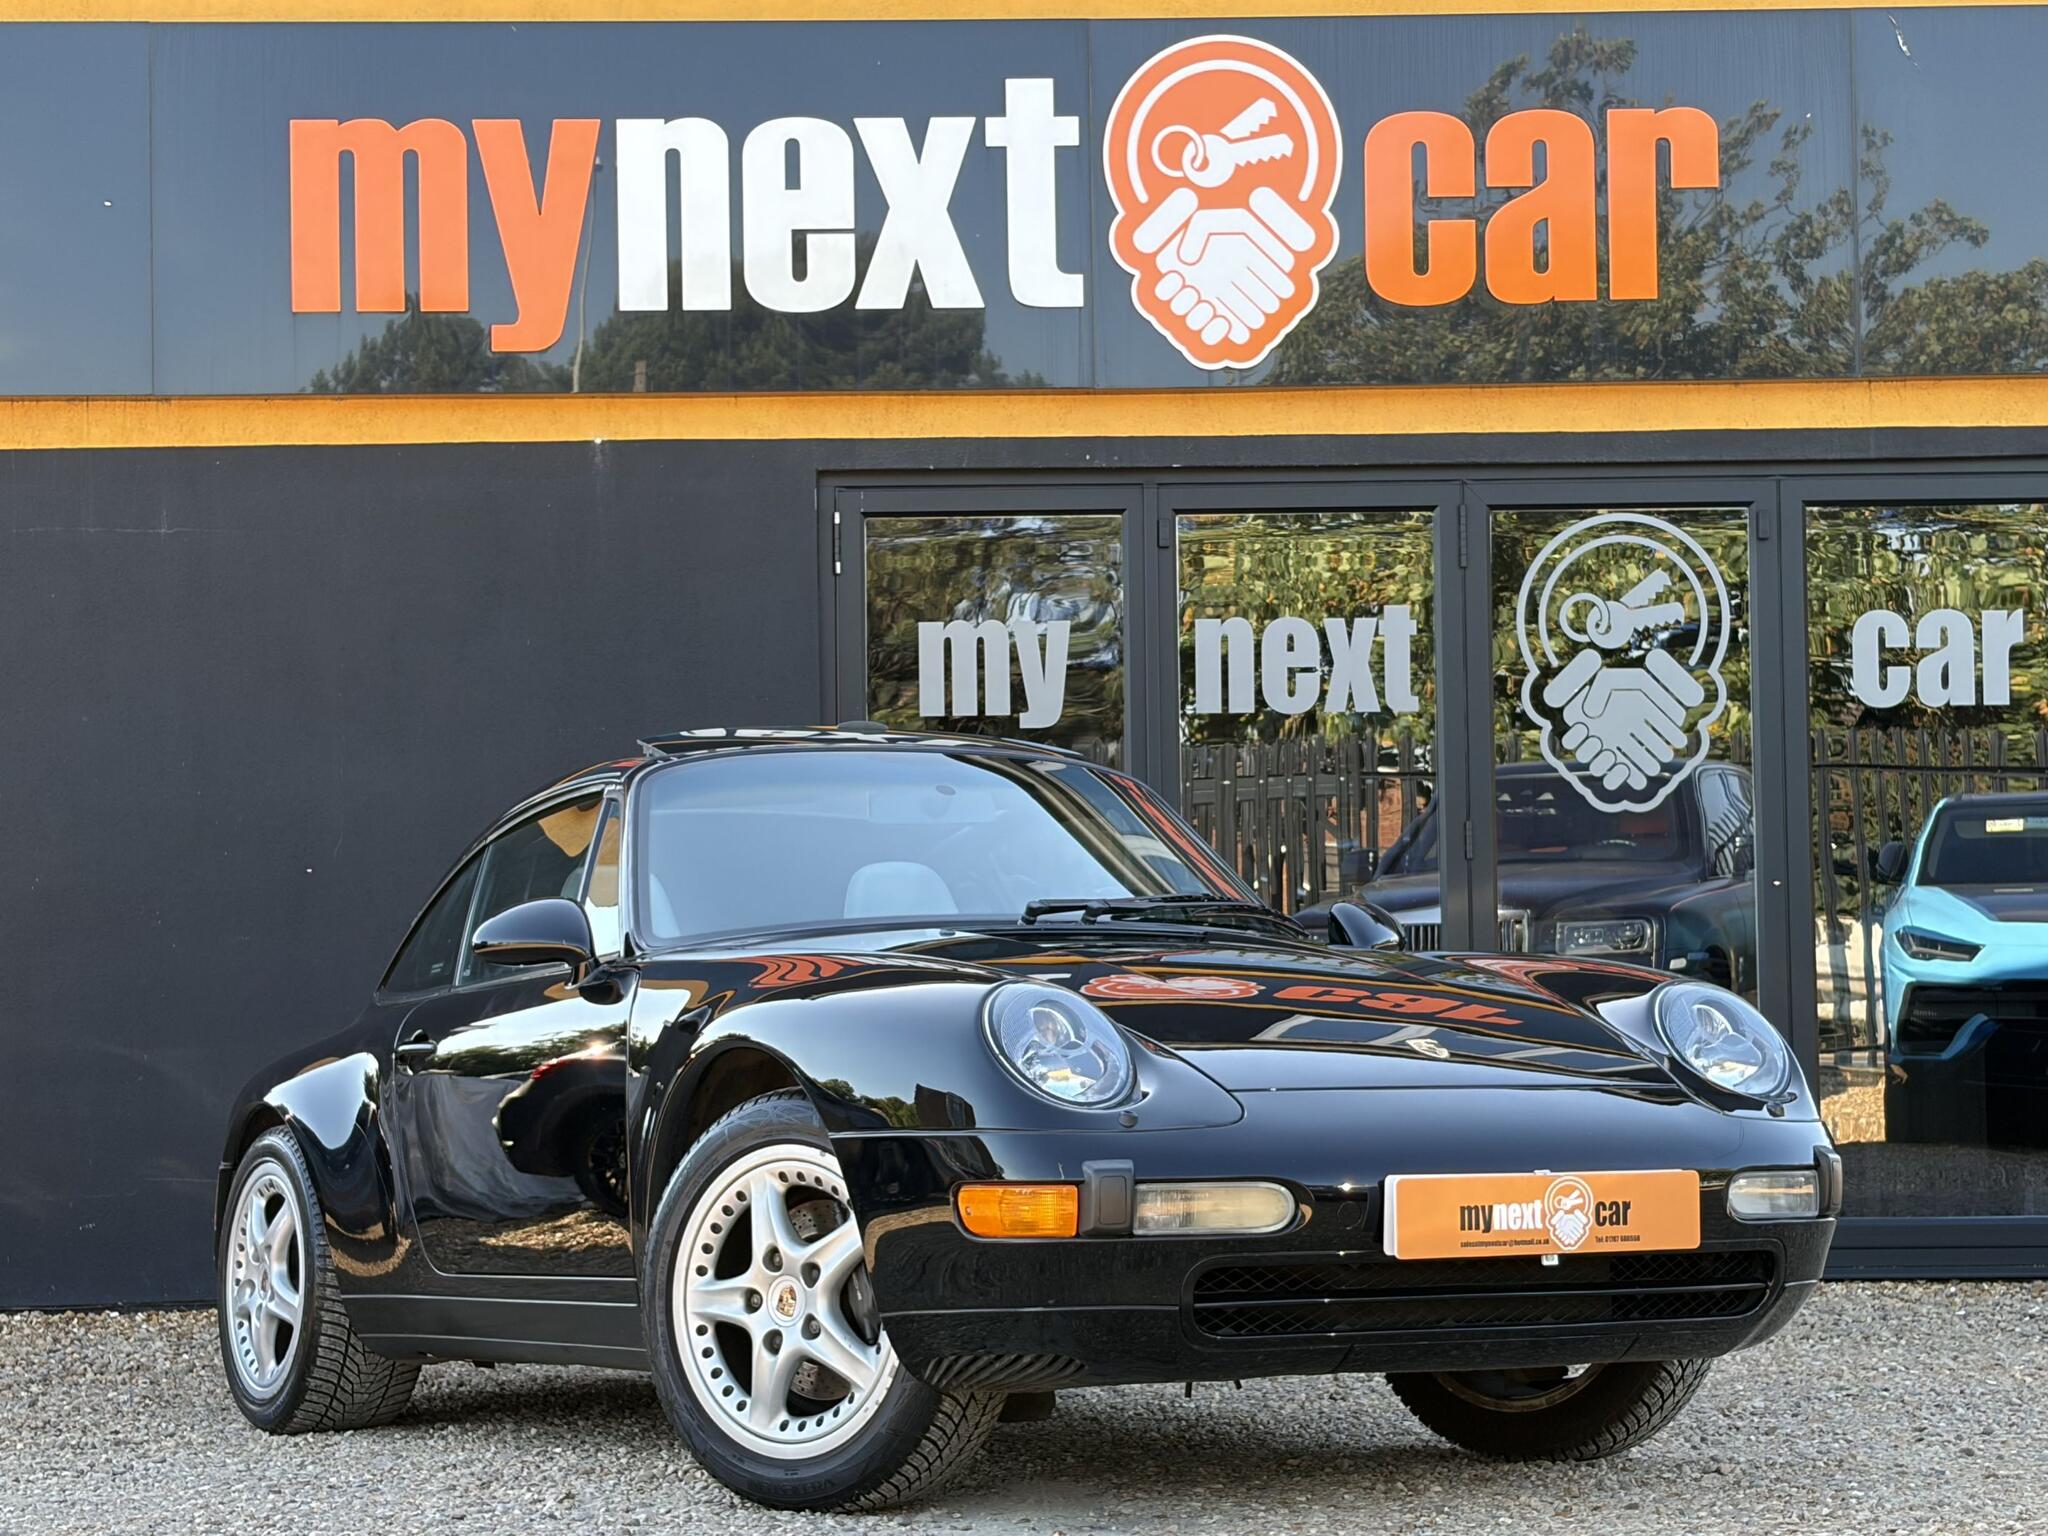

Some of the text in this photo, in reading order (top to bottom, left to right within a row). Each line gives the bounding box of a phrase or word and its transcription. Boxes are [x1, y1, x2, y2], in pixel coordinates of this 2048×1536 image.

[1364, 106, 1719, 306] car
[918, 604, 2024, 729] my next car
[1594, 1201, 1632, 1227] car
